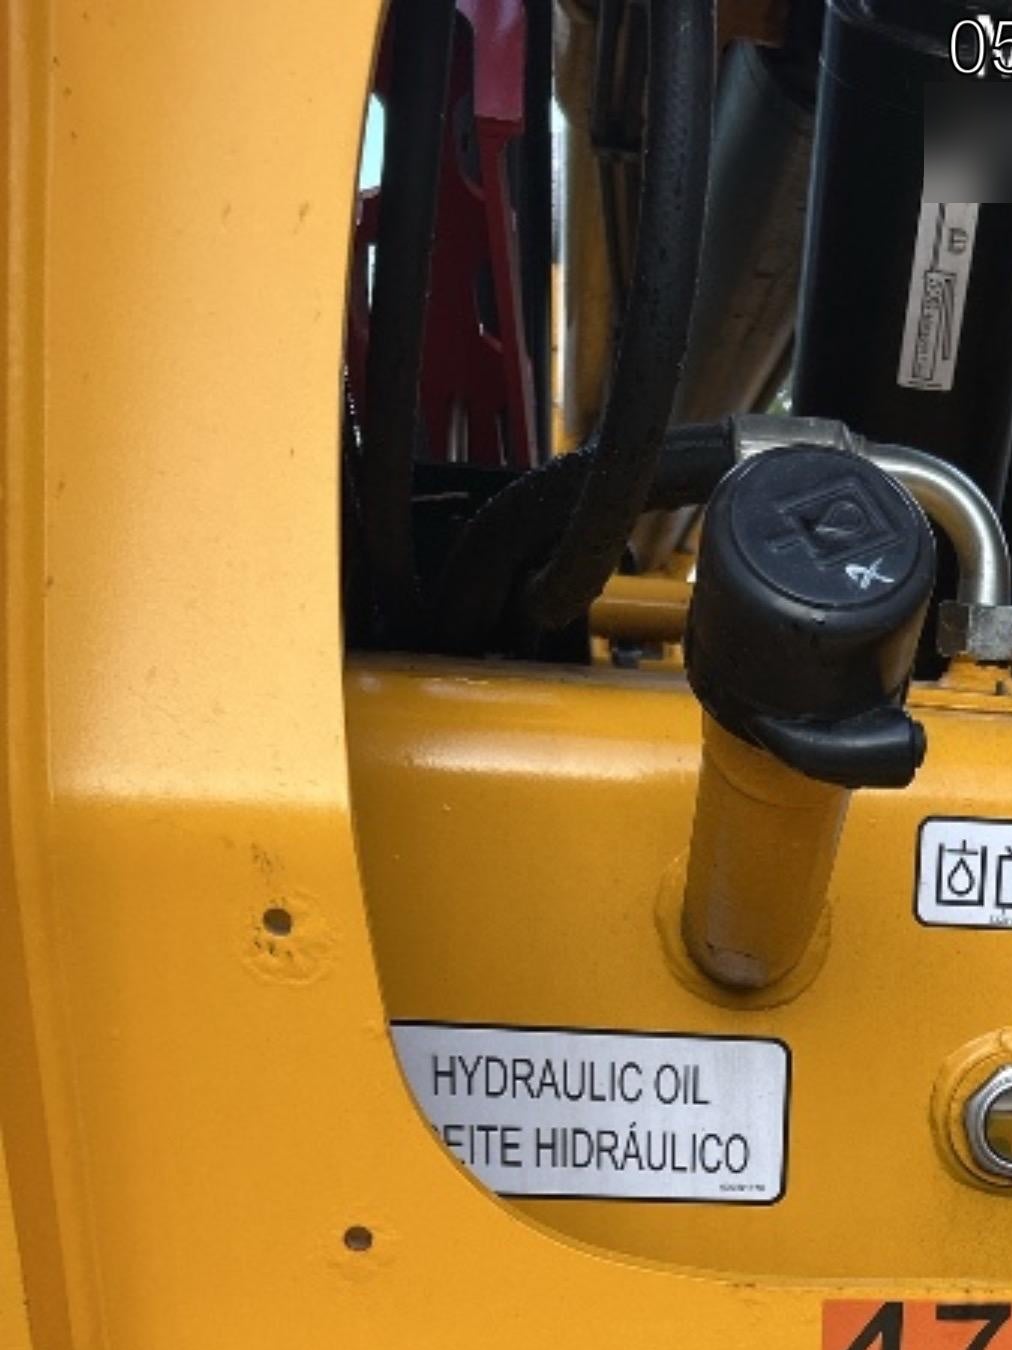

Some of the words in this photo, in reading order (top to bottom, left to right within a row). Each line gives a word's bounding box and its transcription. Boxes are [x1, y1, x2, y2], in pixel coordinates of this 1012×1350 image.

[431, 1055, 643, 1104] HYDRAULIC
[654, 1063, 710, 1105] OIL
[431, 1123, 522, 1168] EITE
[535, 1121, 750, 1174] HIDRÁULICO
